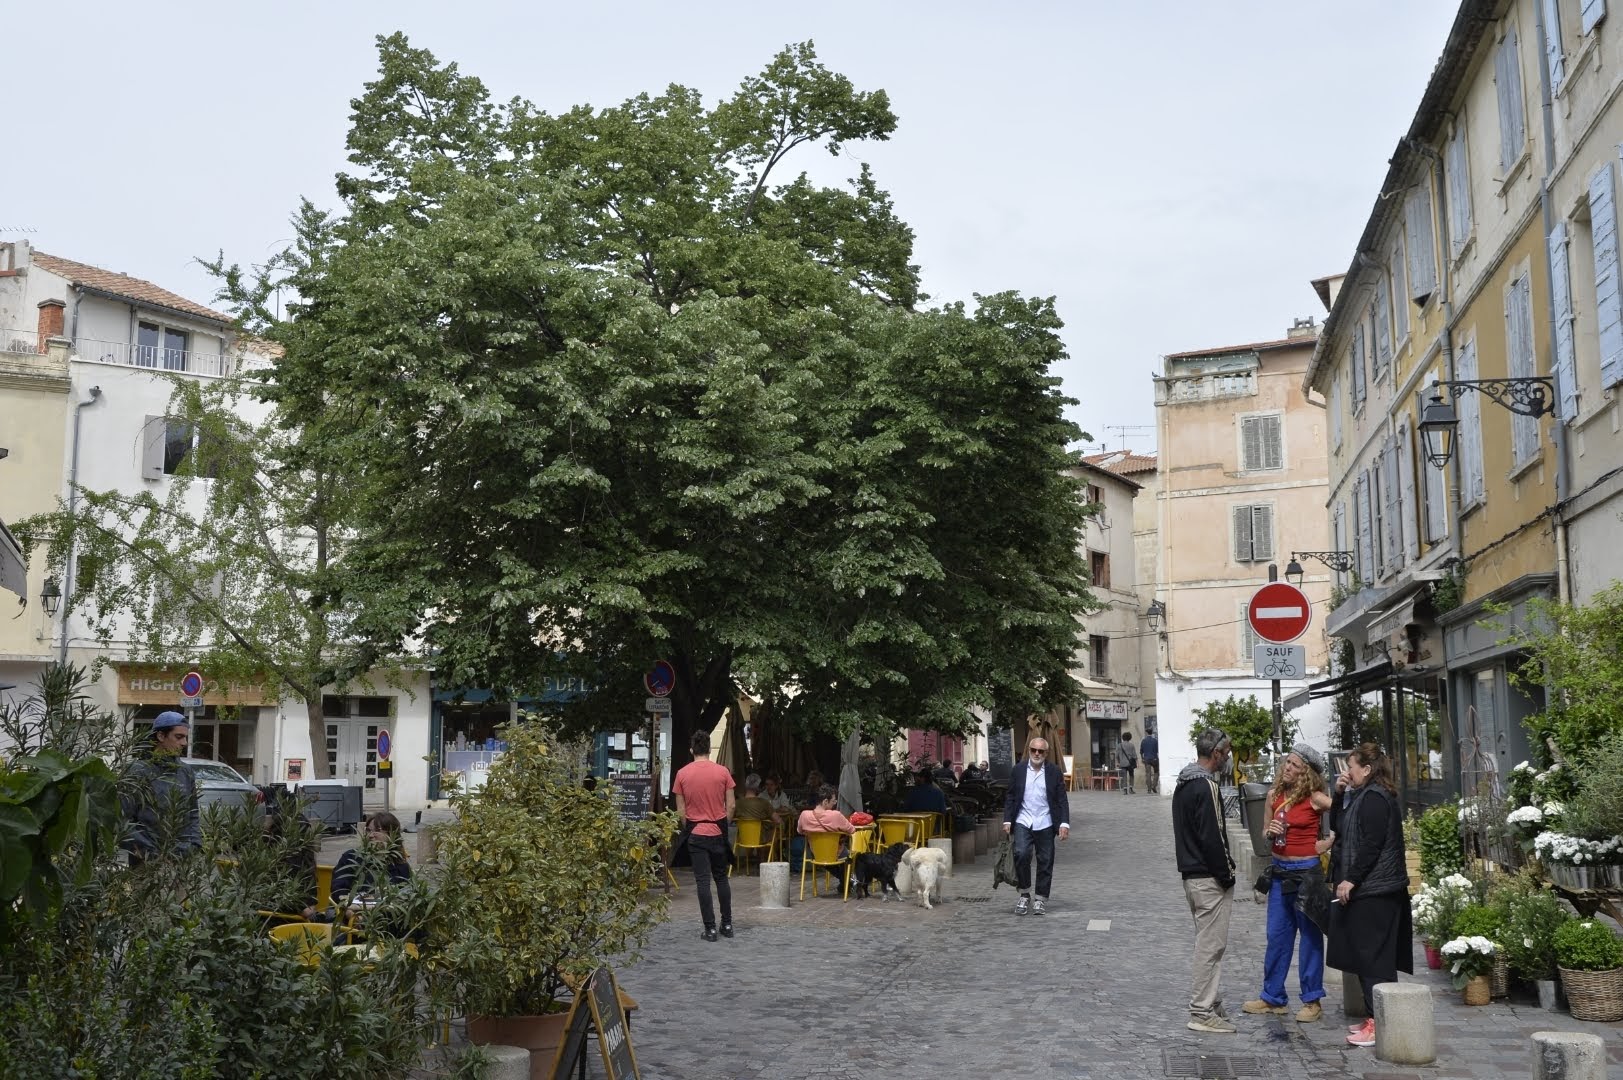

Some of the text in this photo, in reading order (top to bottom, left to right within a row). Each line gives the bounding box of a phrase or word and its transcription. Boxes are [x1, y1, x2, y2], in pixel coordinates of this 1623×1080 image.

[1266, 647, 1294, 657] SAUF
[130, 678, 266, 693] HIGH OIETY
